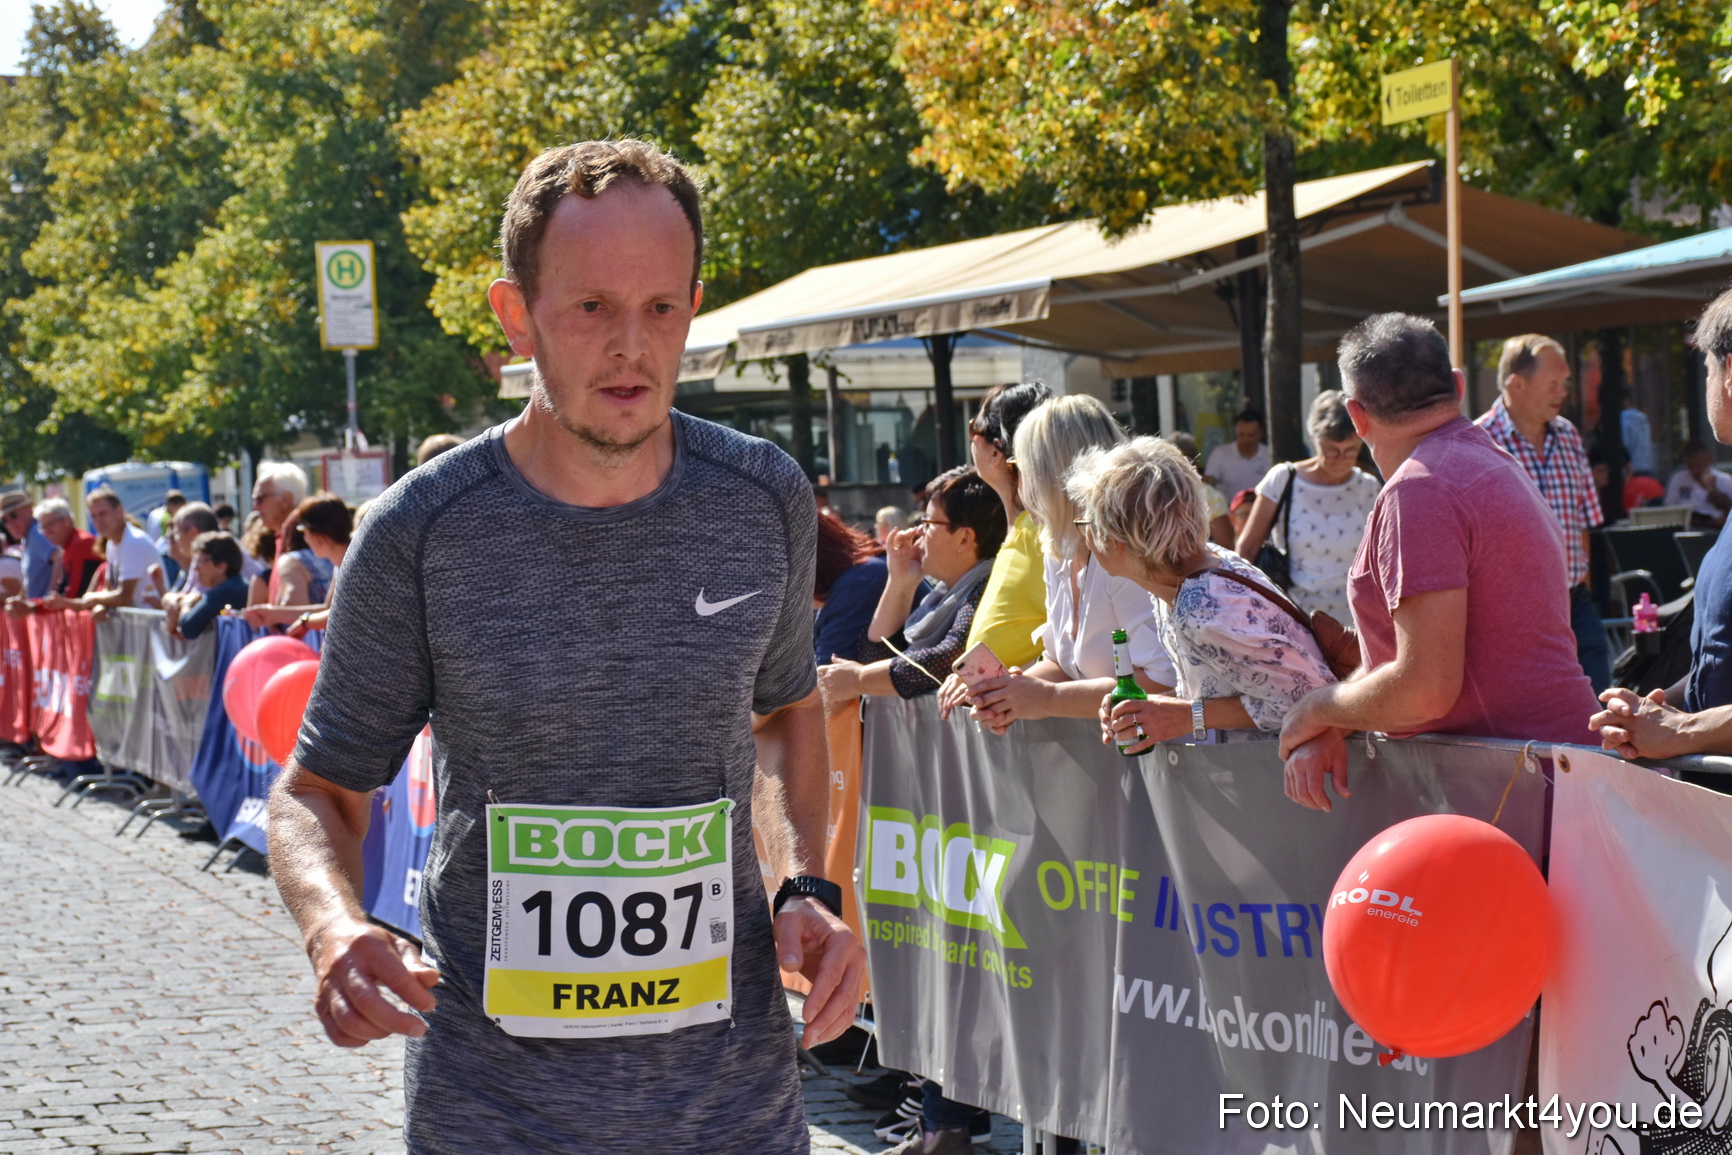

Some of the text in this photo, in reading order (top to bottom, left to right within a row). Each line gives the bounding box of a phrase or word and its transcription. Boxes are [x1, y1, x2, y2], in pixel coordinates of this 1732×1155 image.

[1396, 81, 1448, 107] Toiletten
[337, 261, 355, 280] H
[509, 813, 716, 868] BOCK
[711, 884, 721, 896] B
[521, 881, 704, 958] 1087
[1366, 907, 1419, 927] energie
[553, 978, 680, 1010] FRANZ
